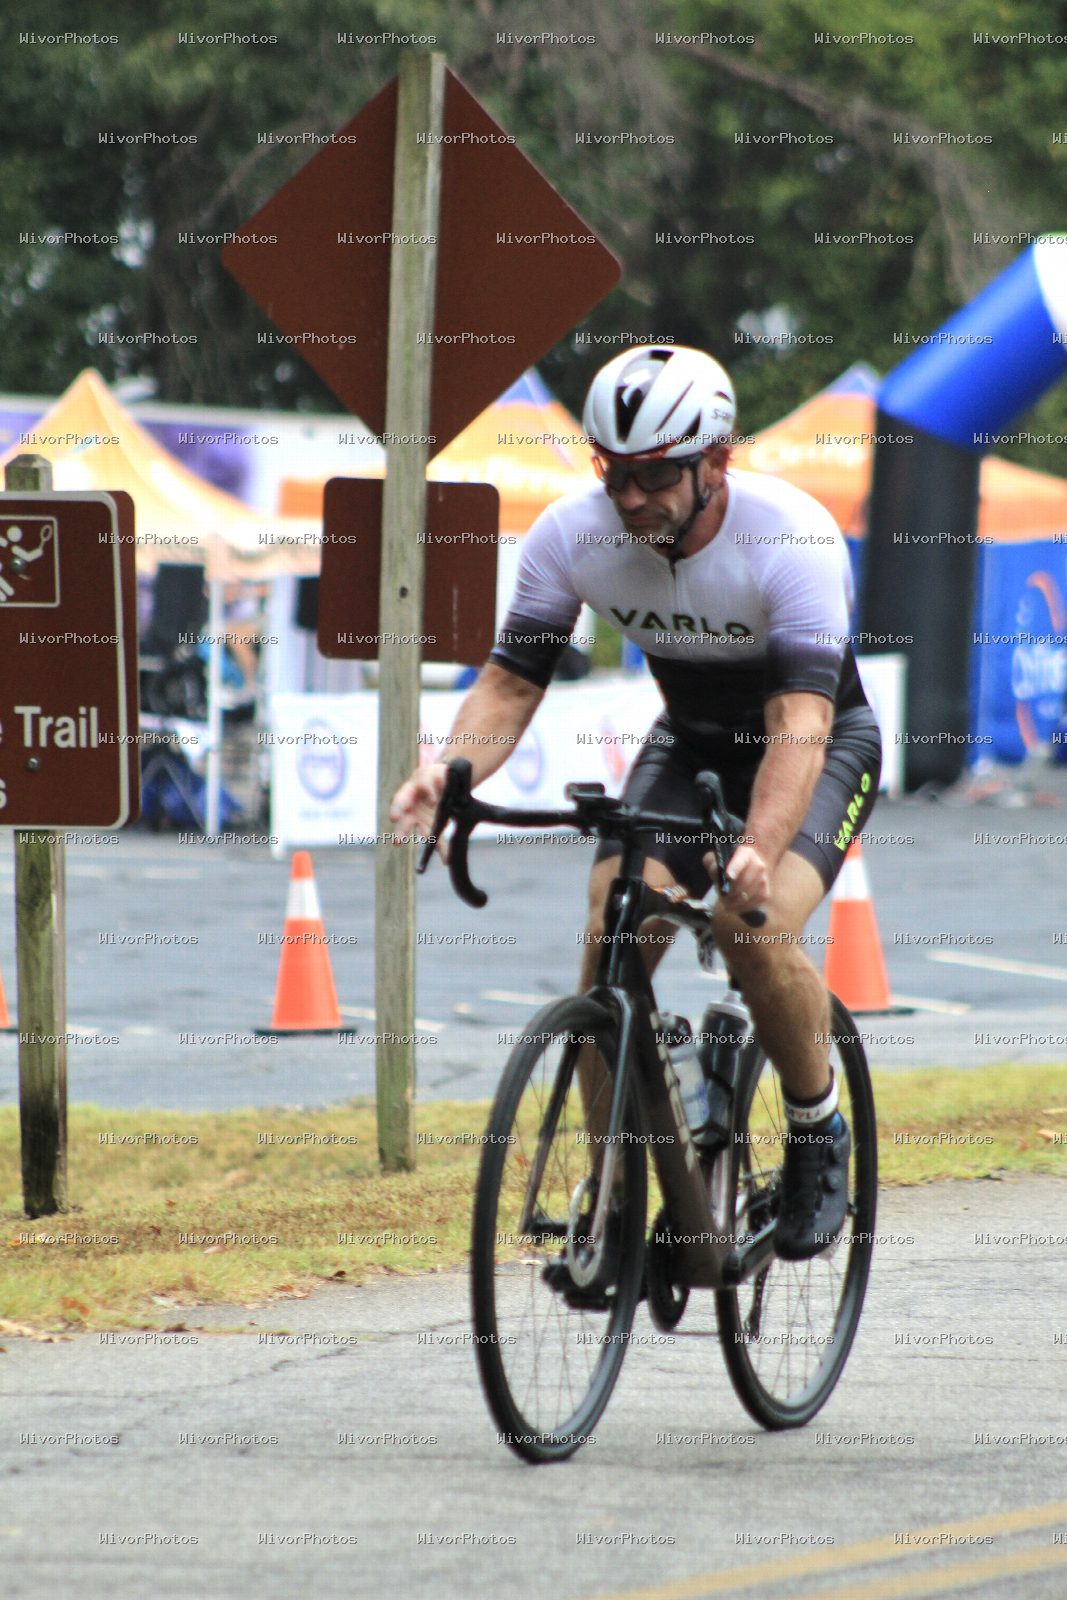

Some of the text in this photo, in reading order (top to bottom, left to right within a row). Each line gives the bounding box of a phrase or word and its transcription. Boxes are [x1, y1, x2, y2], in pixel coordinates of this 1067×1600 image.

[610, 608, 751, 637] VARLO
[14, 706, 98, 748] Trail
[834, 773, 871, 850] VARLO
